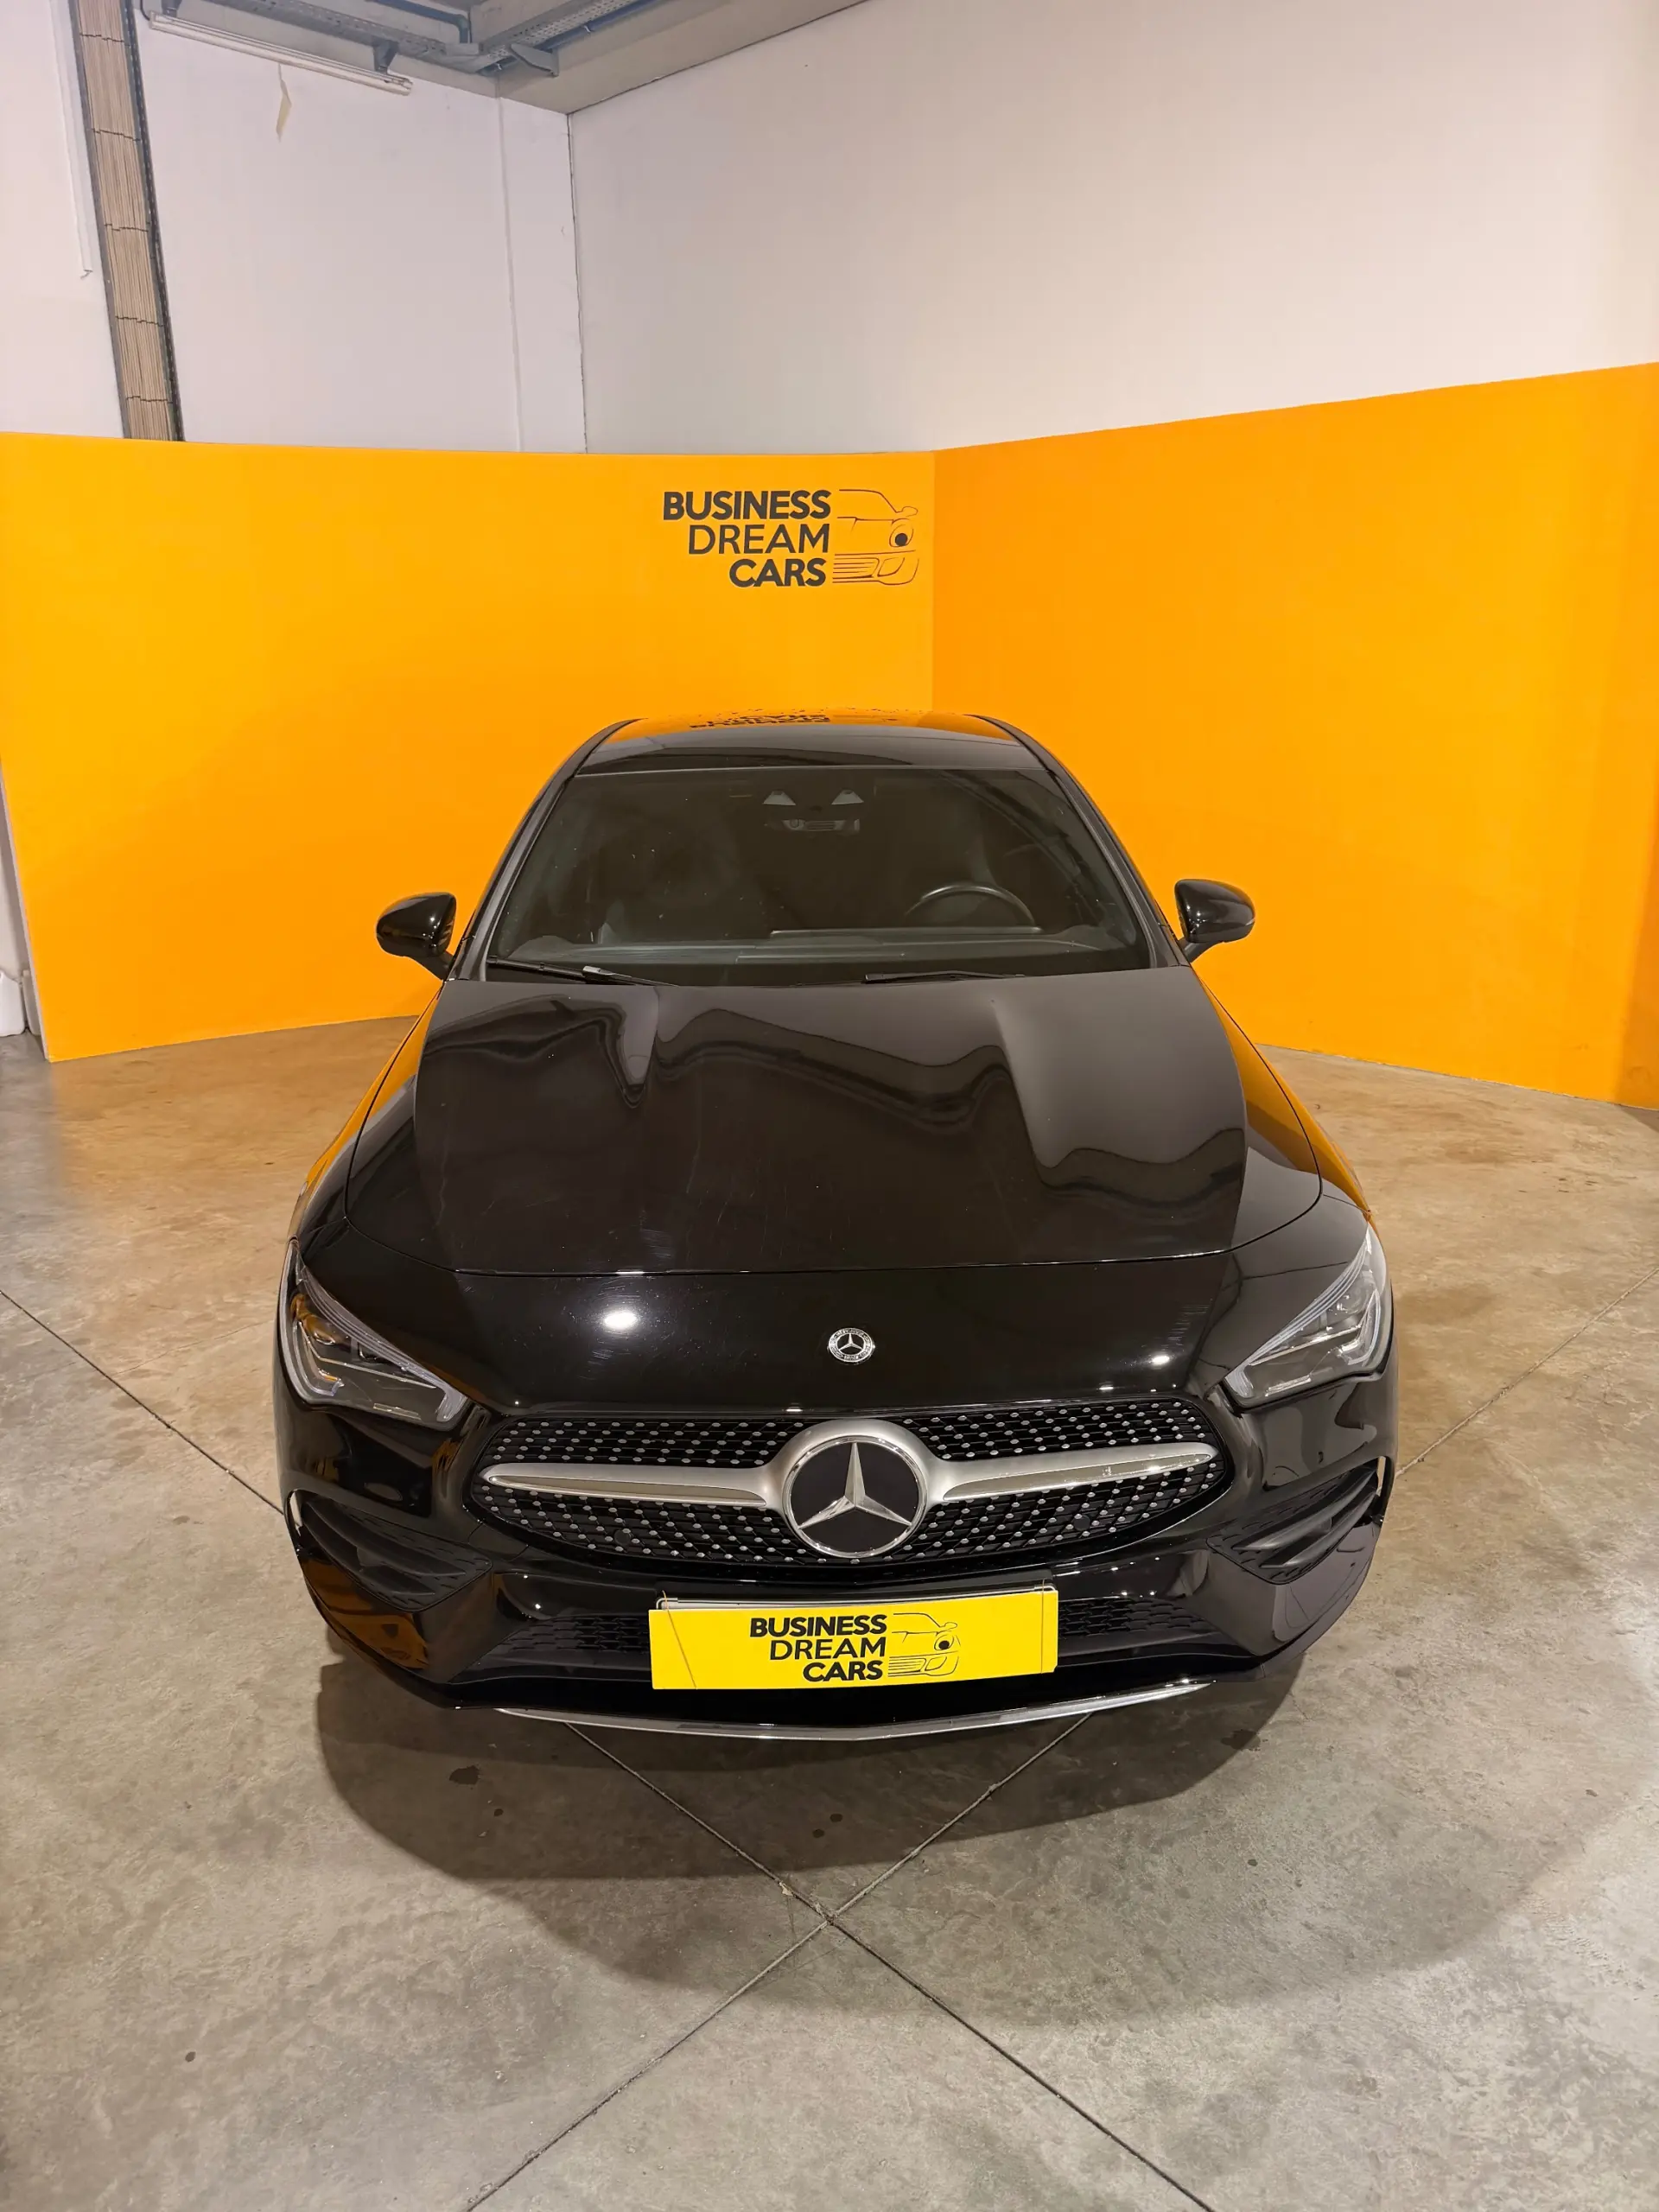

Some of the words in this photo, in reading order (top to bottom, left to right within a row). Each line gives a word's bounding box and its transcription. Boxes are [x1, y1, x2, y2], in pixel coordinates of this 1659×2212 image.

[663, 489, 831, 520] BUSINESS
[689, 524, 830, 554] DREAM
[729, 558, 827, 587] CARS
[750, 1614, 887, 1637] BUSINESS
[770, 1637, 885, 1660] DREAM
[803, 1660, 883, 1681] CARS
